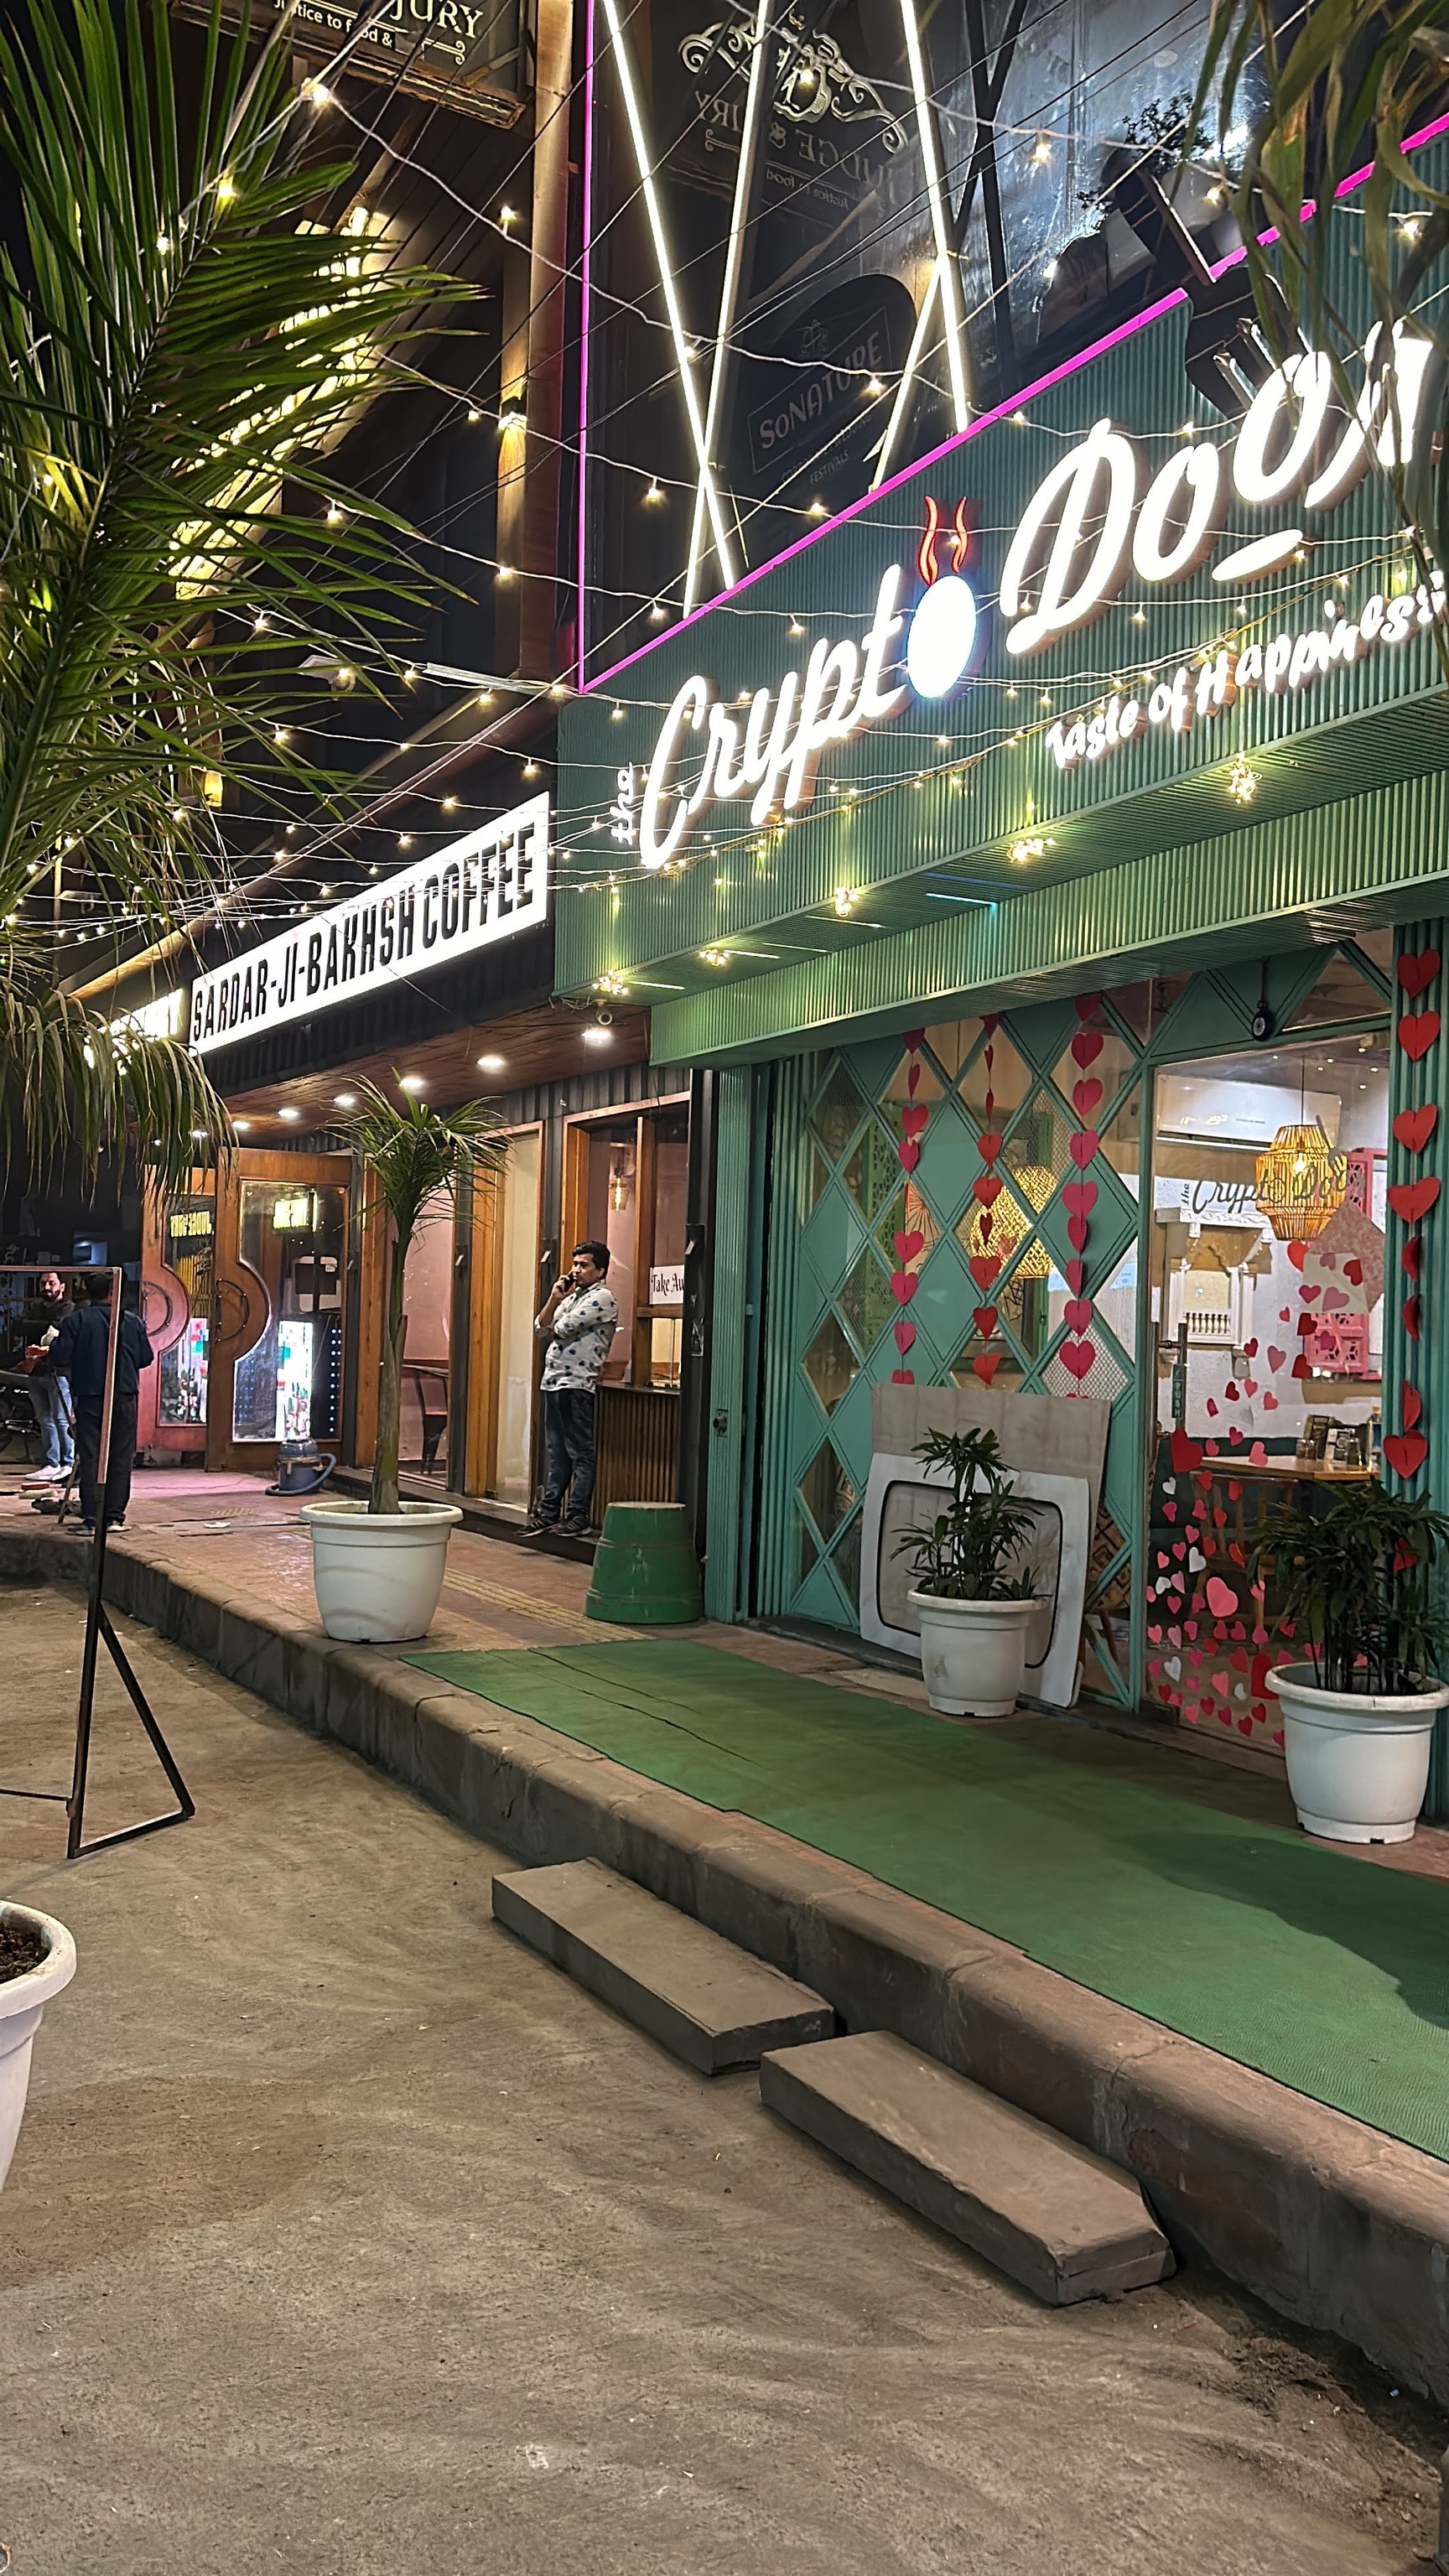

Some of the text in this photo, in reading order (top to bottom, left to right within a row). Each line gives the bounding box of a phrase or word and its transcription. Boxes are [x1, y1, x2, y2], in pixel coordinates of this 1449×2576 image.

[326, 13, 343, 30] to
[345, 18, 378, 44] fod
[382, 32, 393, 48] &
[1045, 695, 1140, 770] Taste
[610, 761, 636, 846] the
[194, 883, 415, 1042] SARDAR-JI-BAKHSH
[422, 821, 535, 949] COFFEE
[651, 1273, 670, 1296] Take
[1174, 1382, 1183, 1417] PUSH
